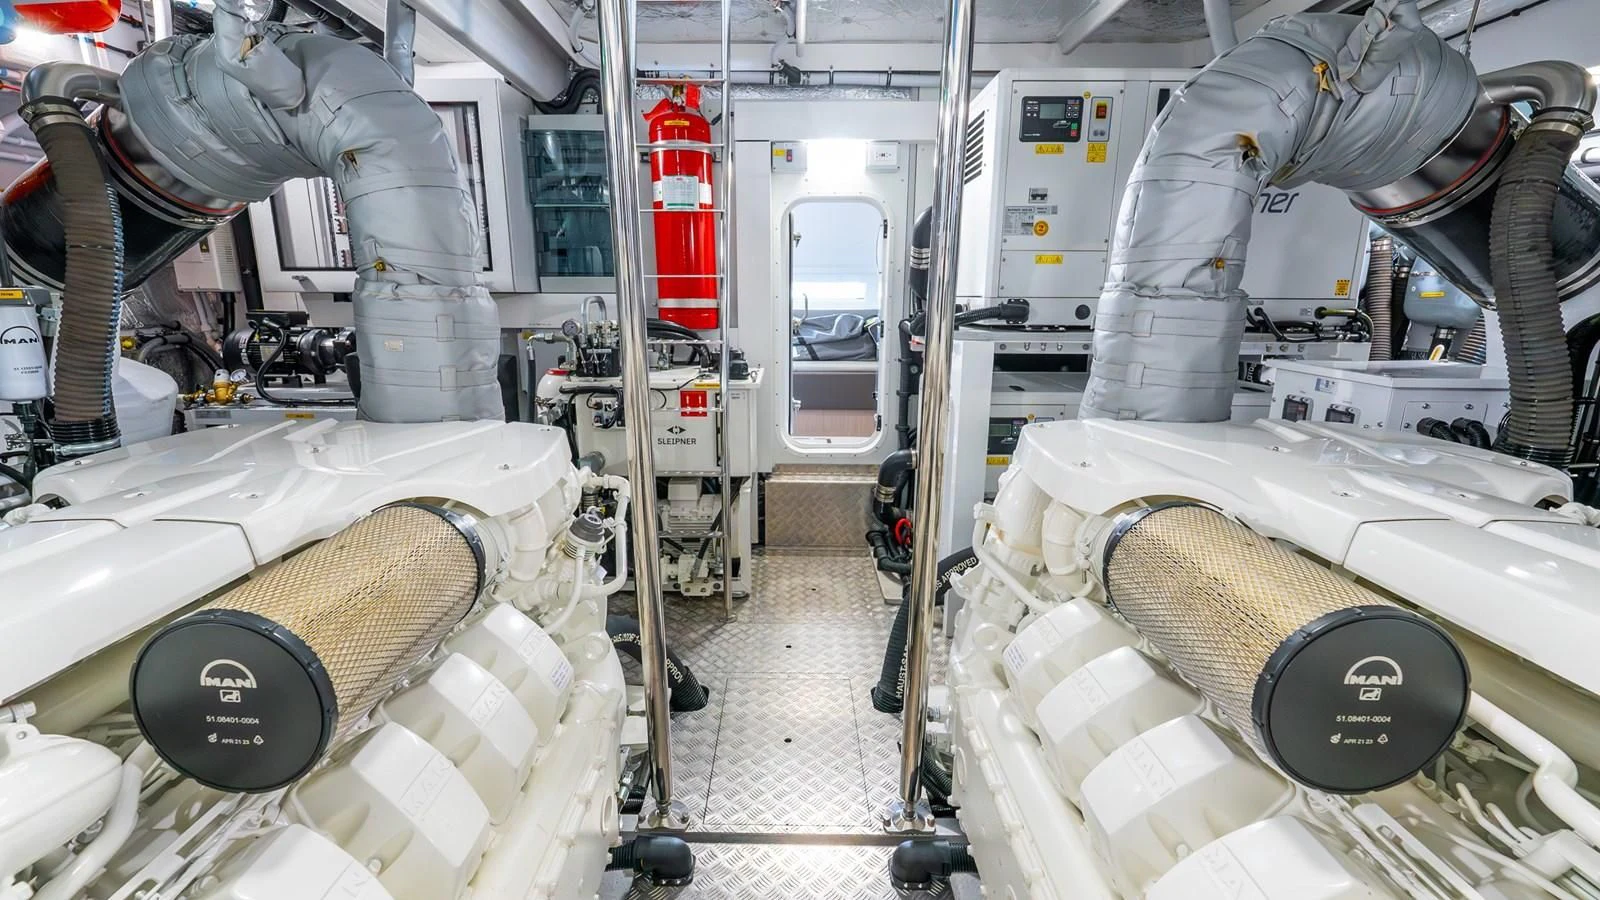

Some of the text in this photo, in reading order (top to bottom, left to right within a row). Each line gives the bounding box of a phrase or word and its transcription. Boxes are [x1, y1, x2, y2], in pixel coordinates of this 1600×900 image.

[657, 437, 697, 446] SLEIPNER
[206, 715, 260, 724] 51.08401-0004
[1336, 715, 1391, 723] 51.08401-0004
